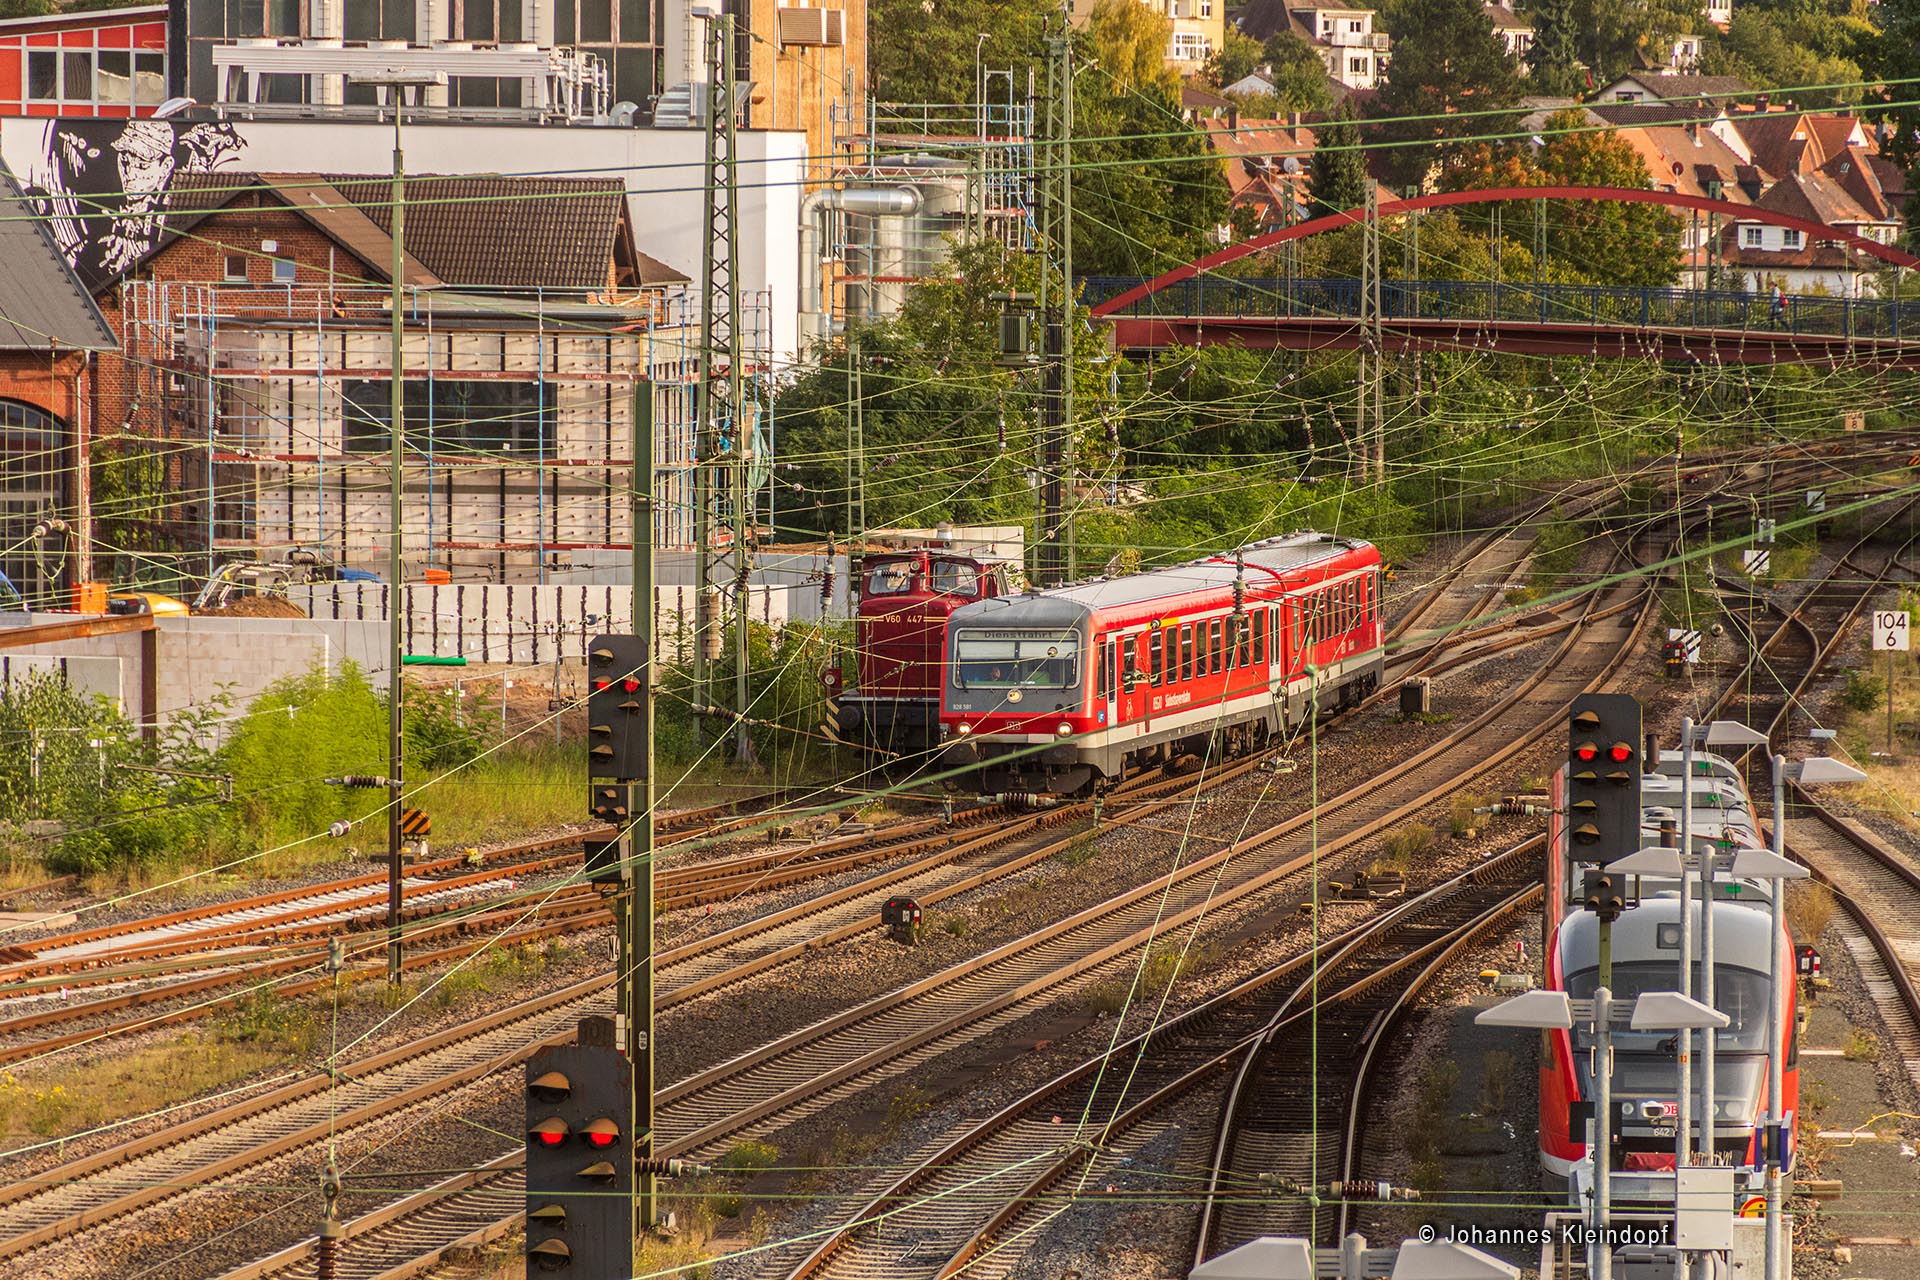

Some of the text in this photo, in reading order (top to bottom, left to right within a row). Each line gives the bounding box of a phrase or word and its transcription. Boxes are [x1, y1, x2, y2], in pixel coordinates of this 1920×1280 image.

[885, 615, 922, 623] V60 447
[1876, 613, 1906, 629] 104
[984, 631, 1052, 639] Dienstfahrt
[1886, 631, 1896, 646] 6
[1653, 1128, 1669, 1137] 642
